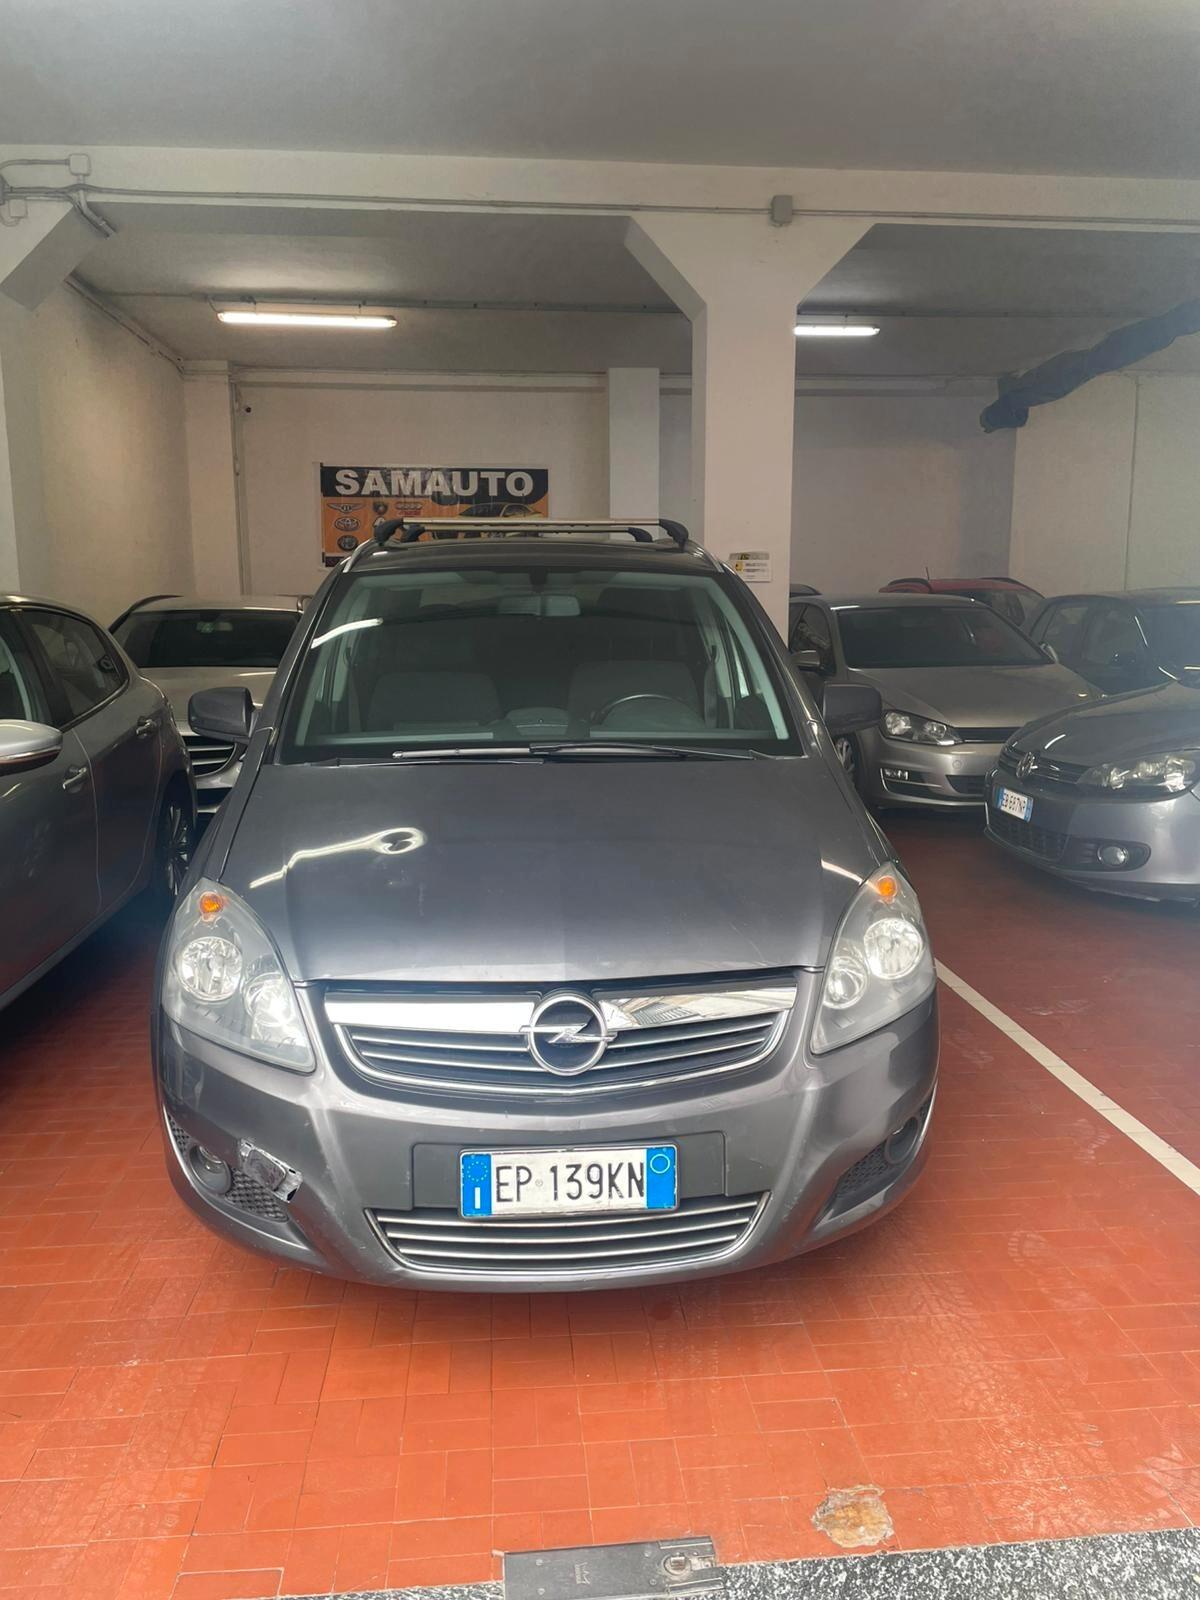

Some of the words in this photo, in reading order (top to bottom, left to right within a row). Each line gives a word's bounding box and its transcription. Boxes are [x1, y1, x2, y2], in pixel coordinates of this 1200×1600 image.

[335, 469, 534, 497] SAMAUTO
[495, 1165, 533, 1203] EP
[549, 1161, 646, 1201] 139KN
